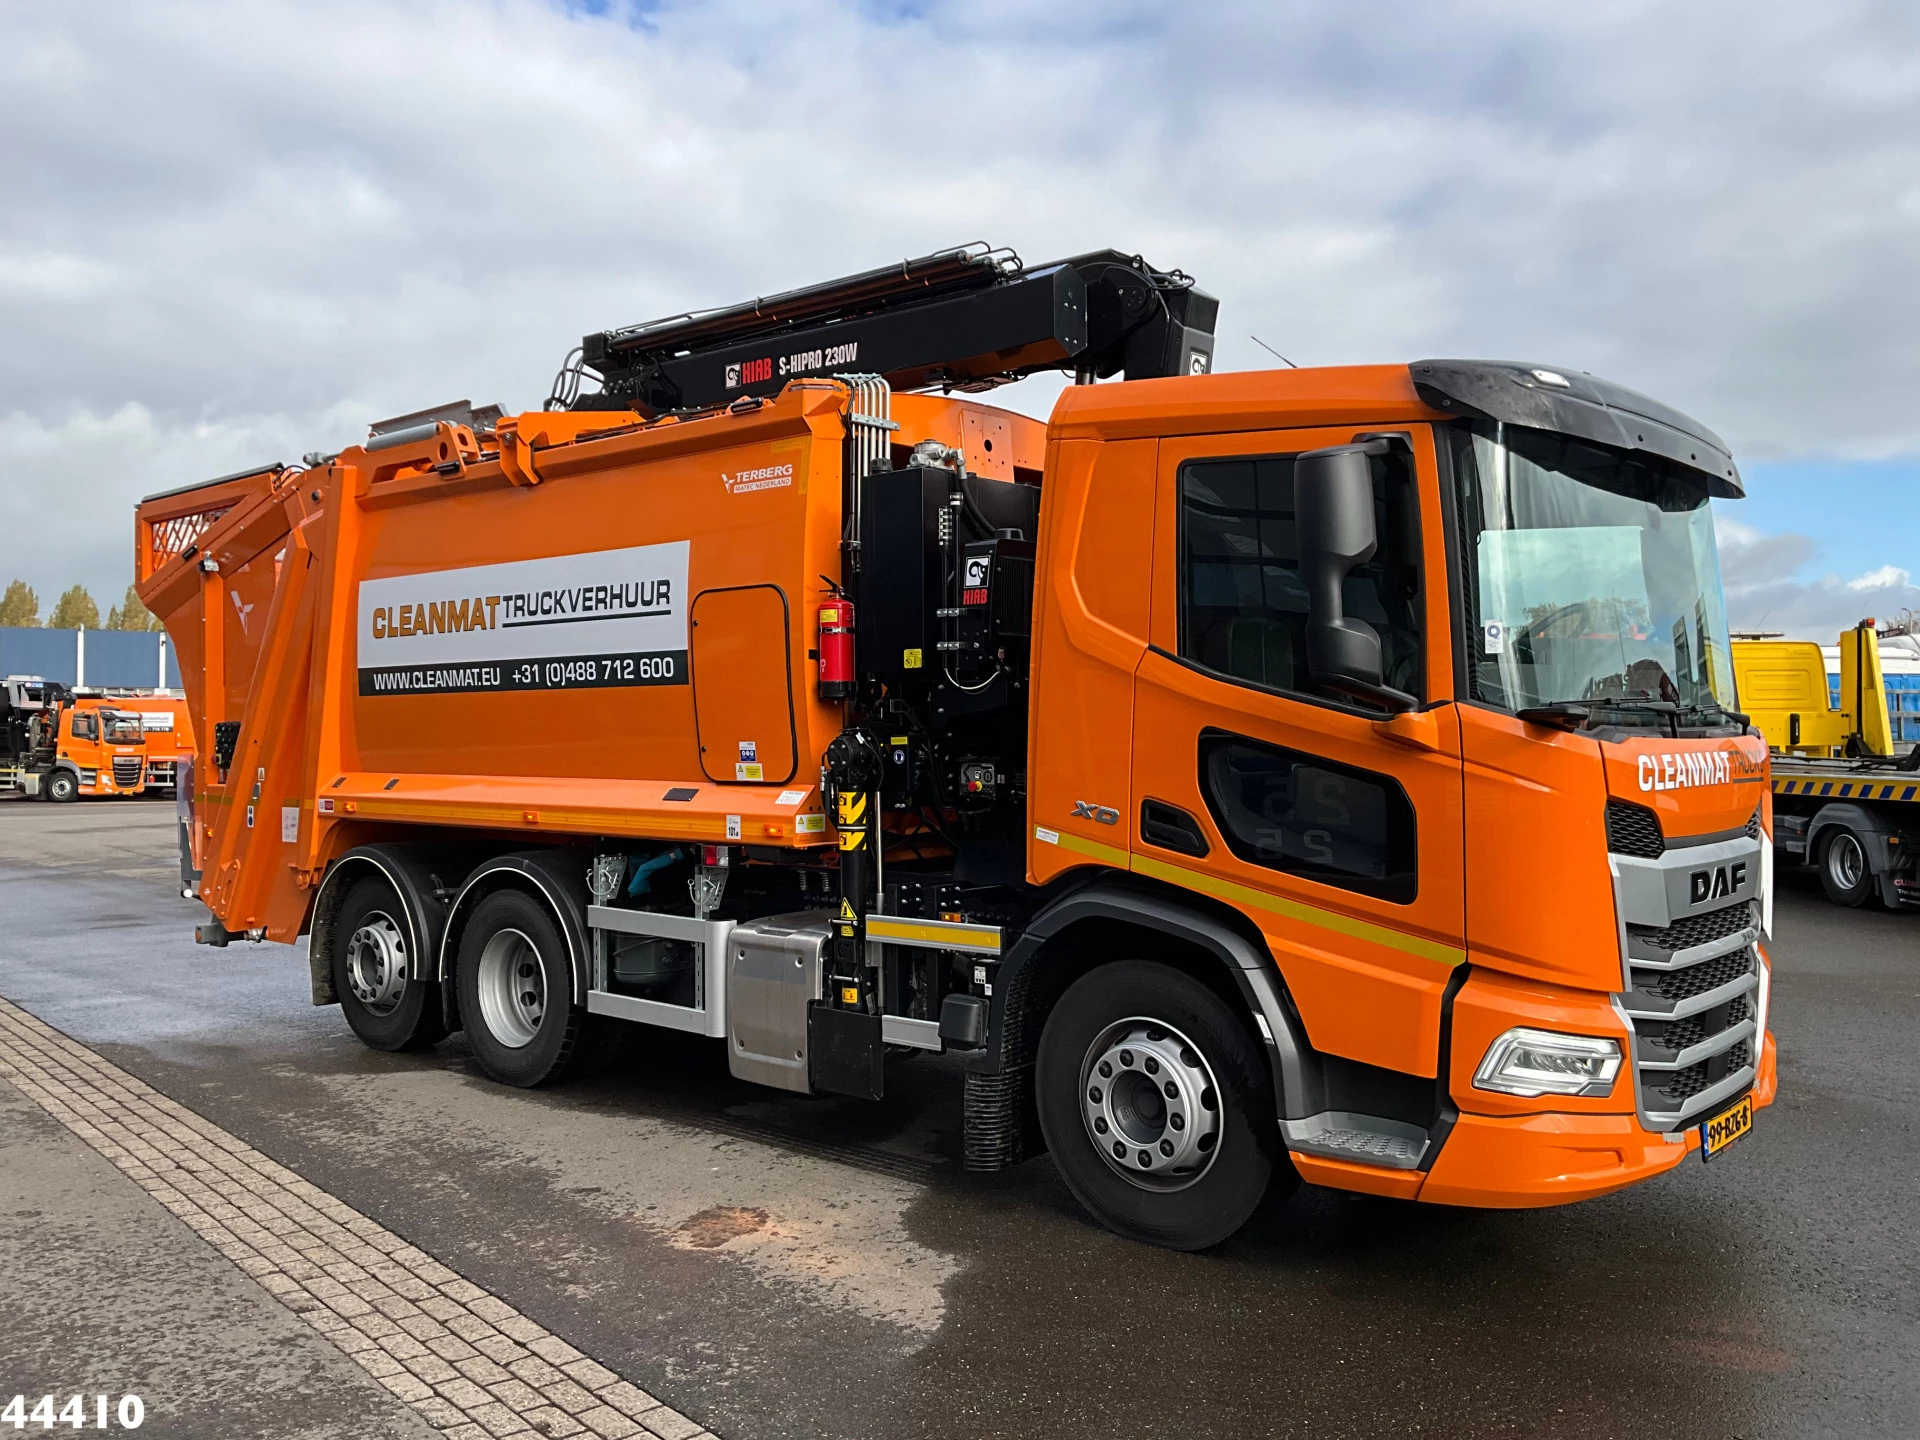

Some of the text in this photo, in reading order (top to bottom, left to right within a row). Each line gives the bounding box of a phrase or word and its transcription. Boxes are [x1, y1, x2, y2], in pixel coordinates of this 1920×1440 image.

[742, 342, 858, 384] HIAB S-HIPRO 230W
[734, 478, 790, 492] MATEC NEDERLAND
[736, 464, 793, 482] TERBERG
[372, 580, 671, 639] CLEANMAT TRUCKVERHUUR
[963, 589, 988, 605] HIAB
[373, 657, 674, 691] WWW.CLEANMAT.EU +31 (0)488 712 600
[1637, 751, 1730, 792] CLEANMAT
[1071, 800, 1119, 825] XD
[1689, 861, 1746, 905] DAF
[1709, 1105, 1748, 1148] 99-BZG-8
